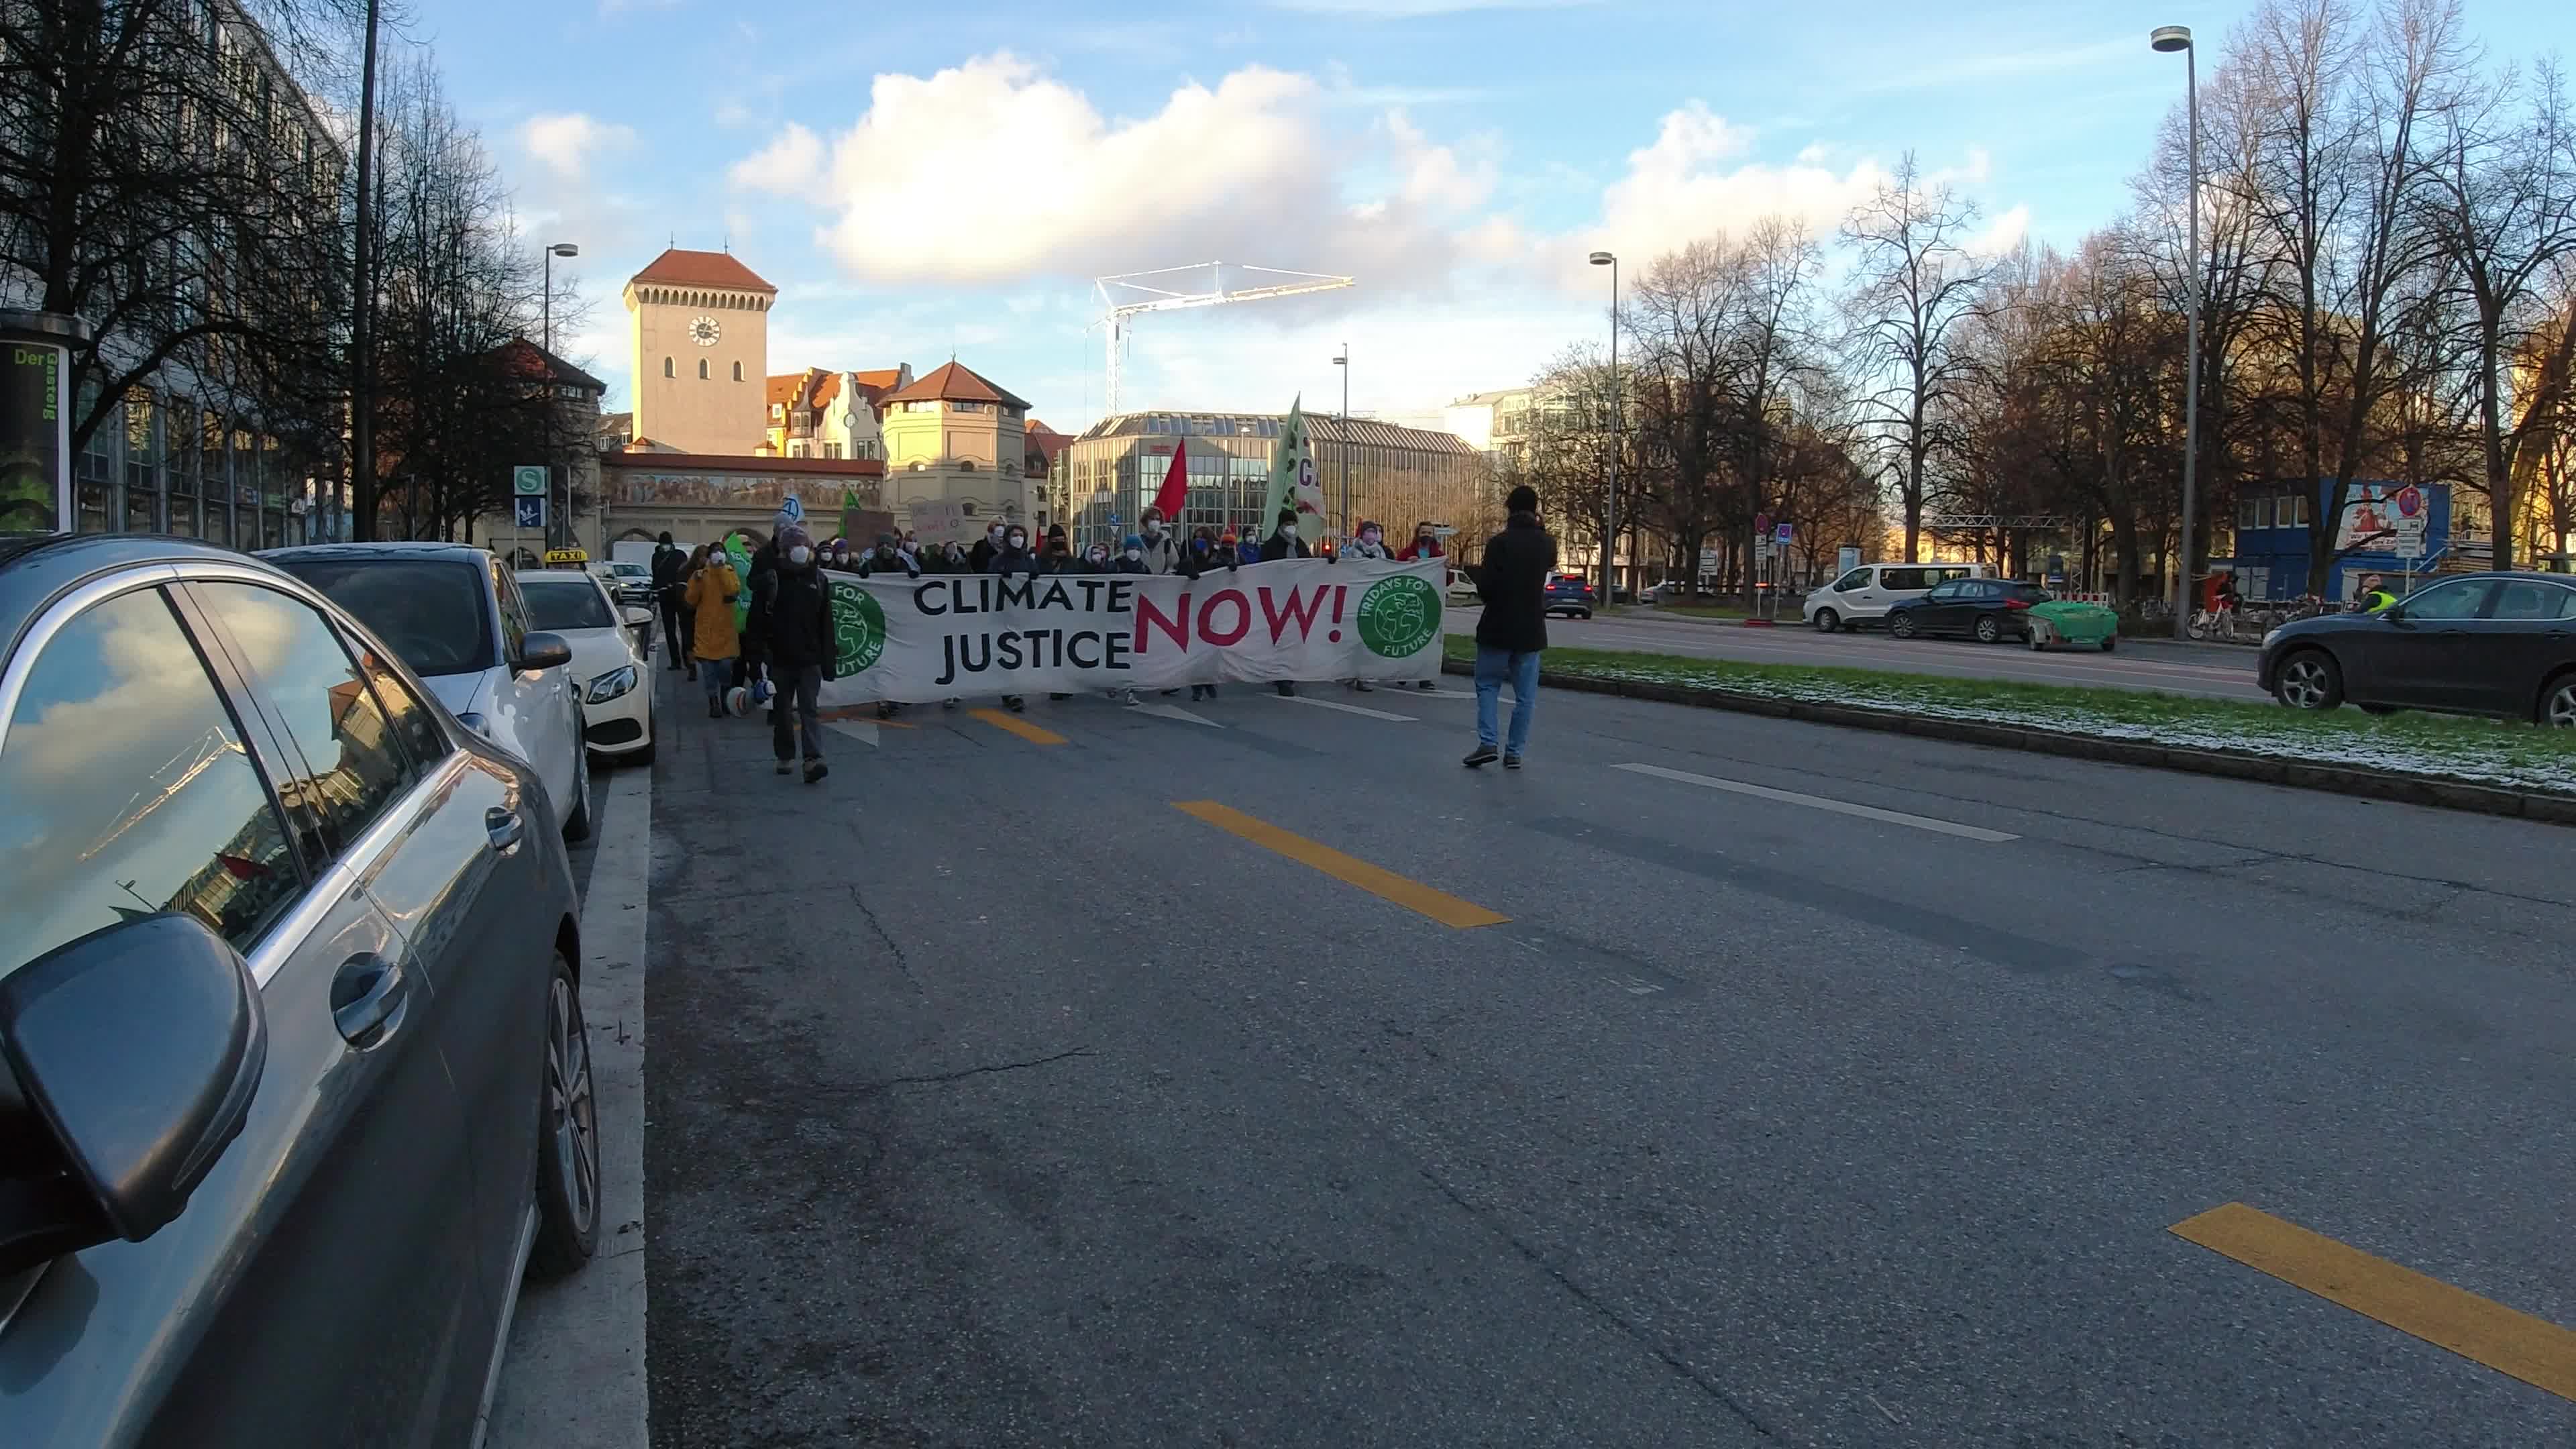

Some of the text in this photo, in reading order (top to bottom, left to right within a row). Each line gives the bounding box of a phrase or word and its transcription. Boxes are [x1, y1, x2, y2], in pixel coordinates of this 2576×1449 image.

[15, 349, 44, 366] Der
[521, 471, 537, 490] S
[551, 551, 581, 560] TAXI
[835, 586, 865, 605] FOR
[913, 579, 1133, 616] CLIMATE
[1360, 578, 1402, 617] FRIDAYS
[1134, 584, 1348, 654] NOW!
[835, 640, 882, 676] UTURE
[934, 629, 1131, 685] JUSTICE
[1383, 628, 1434, 656] FUTURE
